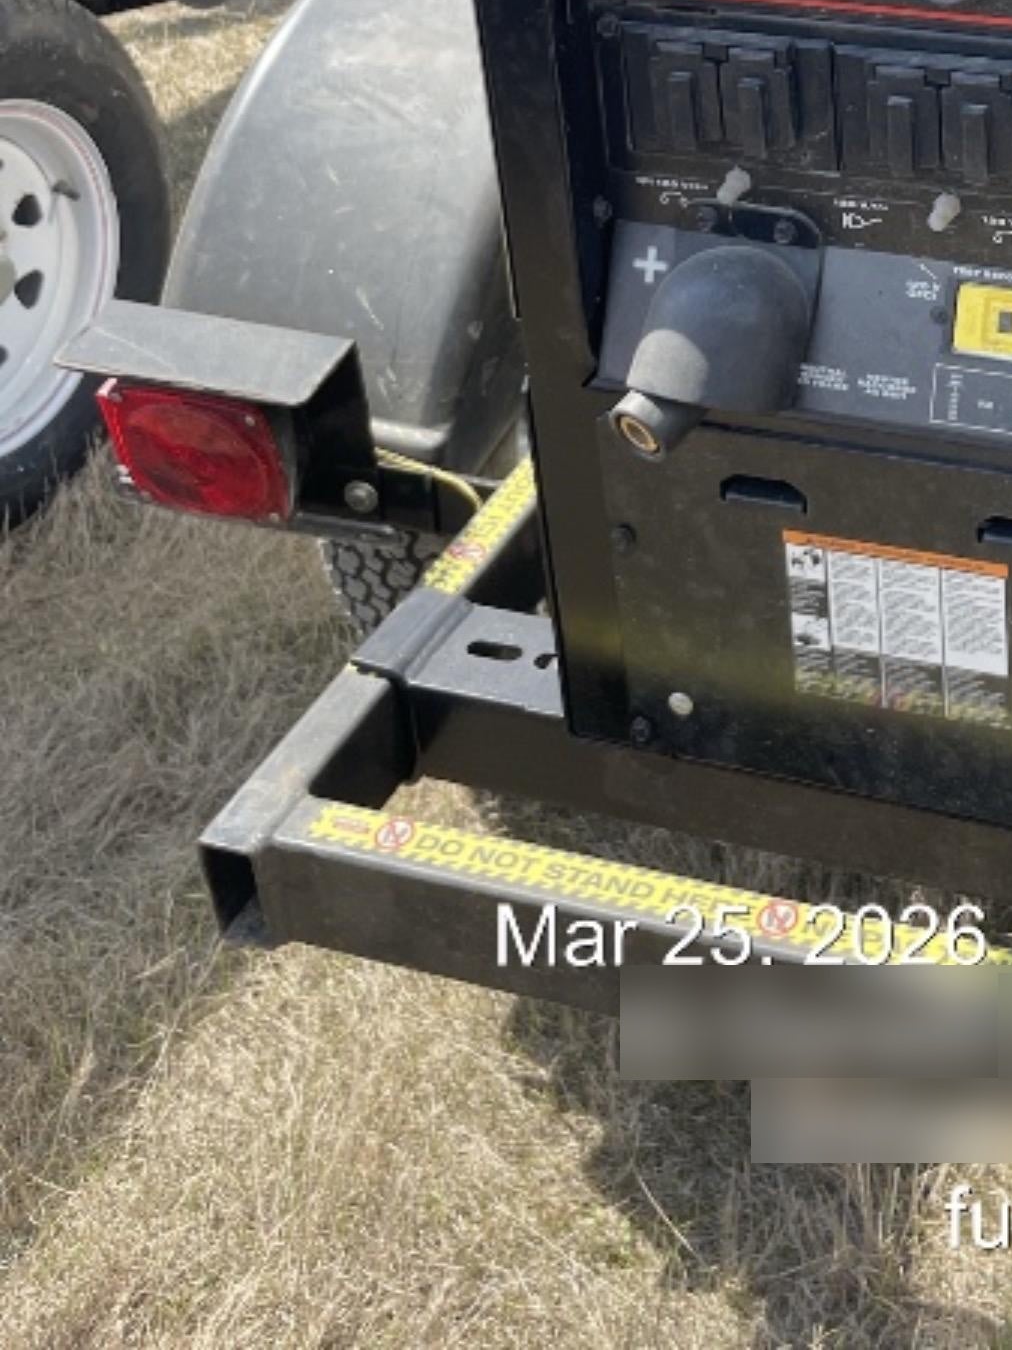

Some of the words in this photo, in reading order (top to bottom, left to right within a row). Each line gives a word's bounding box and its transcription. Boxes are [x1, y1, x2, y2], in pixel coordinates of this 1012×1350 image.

[414, 832, 466, 856] DO
[469, 844, 541, 875] NOT
[545, 861, 656, 899] STAND
